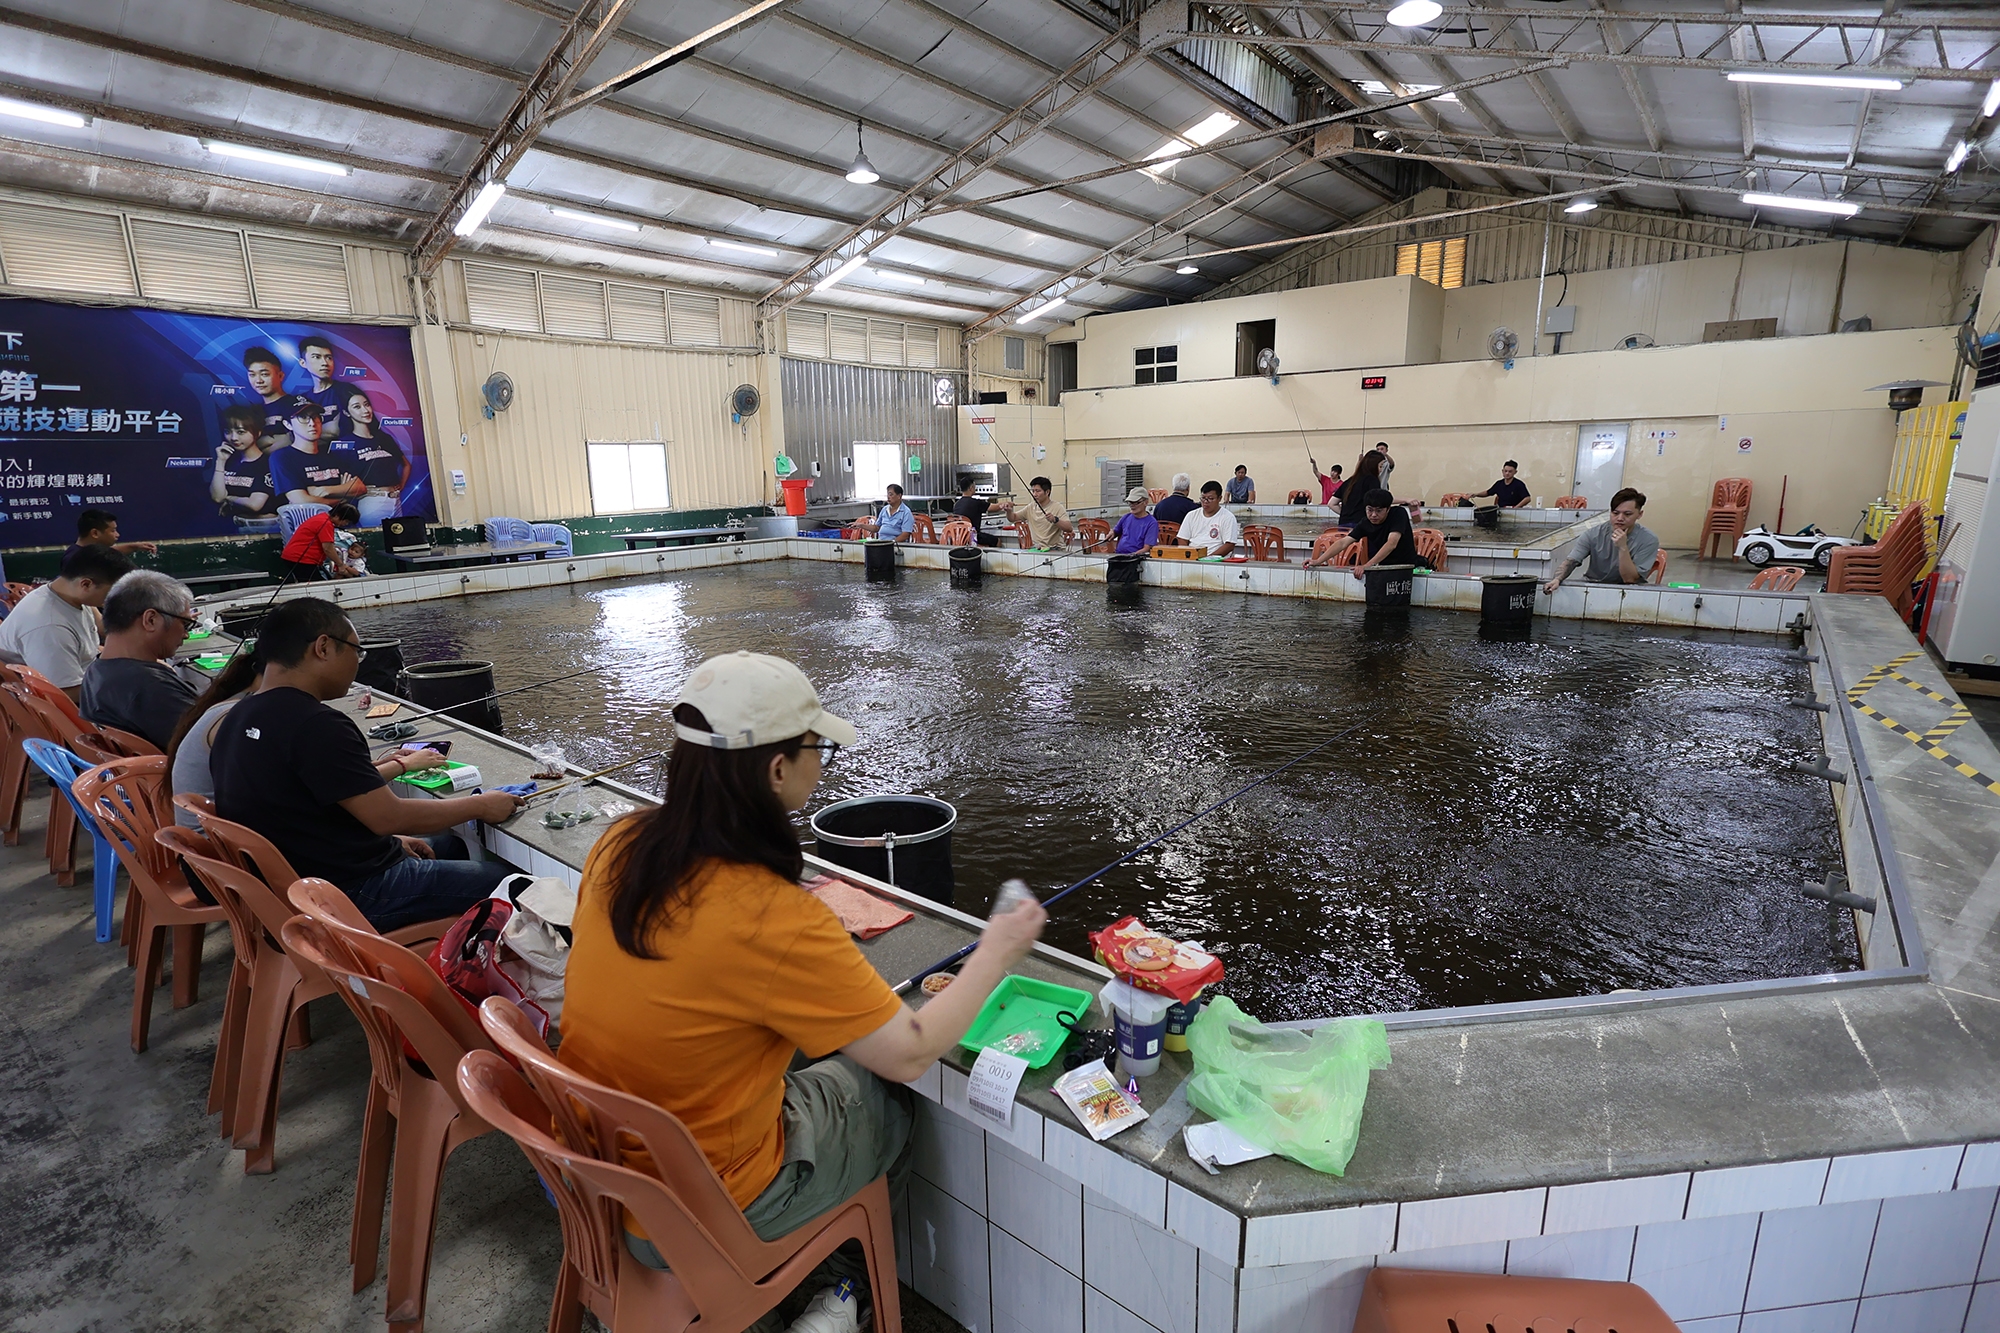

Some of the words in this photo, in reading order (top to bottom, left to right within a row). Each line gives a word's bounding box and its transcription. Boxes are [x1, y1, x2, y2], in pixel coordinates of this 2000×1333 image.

[0, 369, 82, 403] 第一
[988, 1064, 1013, 1081] 0019
[972, 1075, 995, 1089] 09月10日
